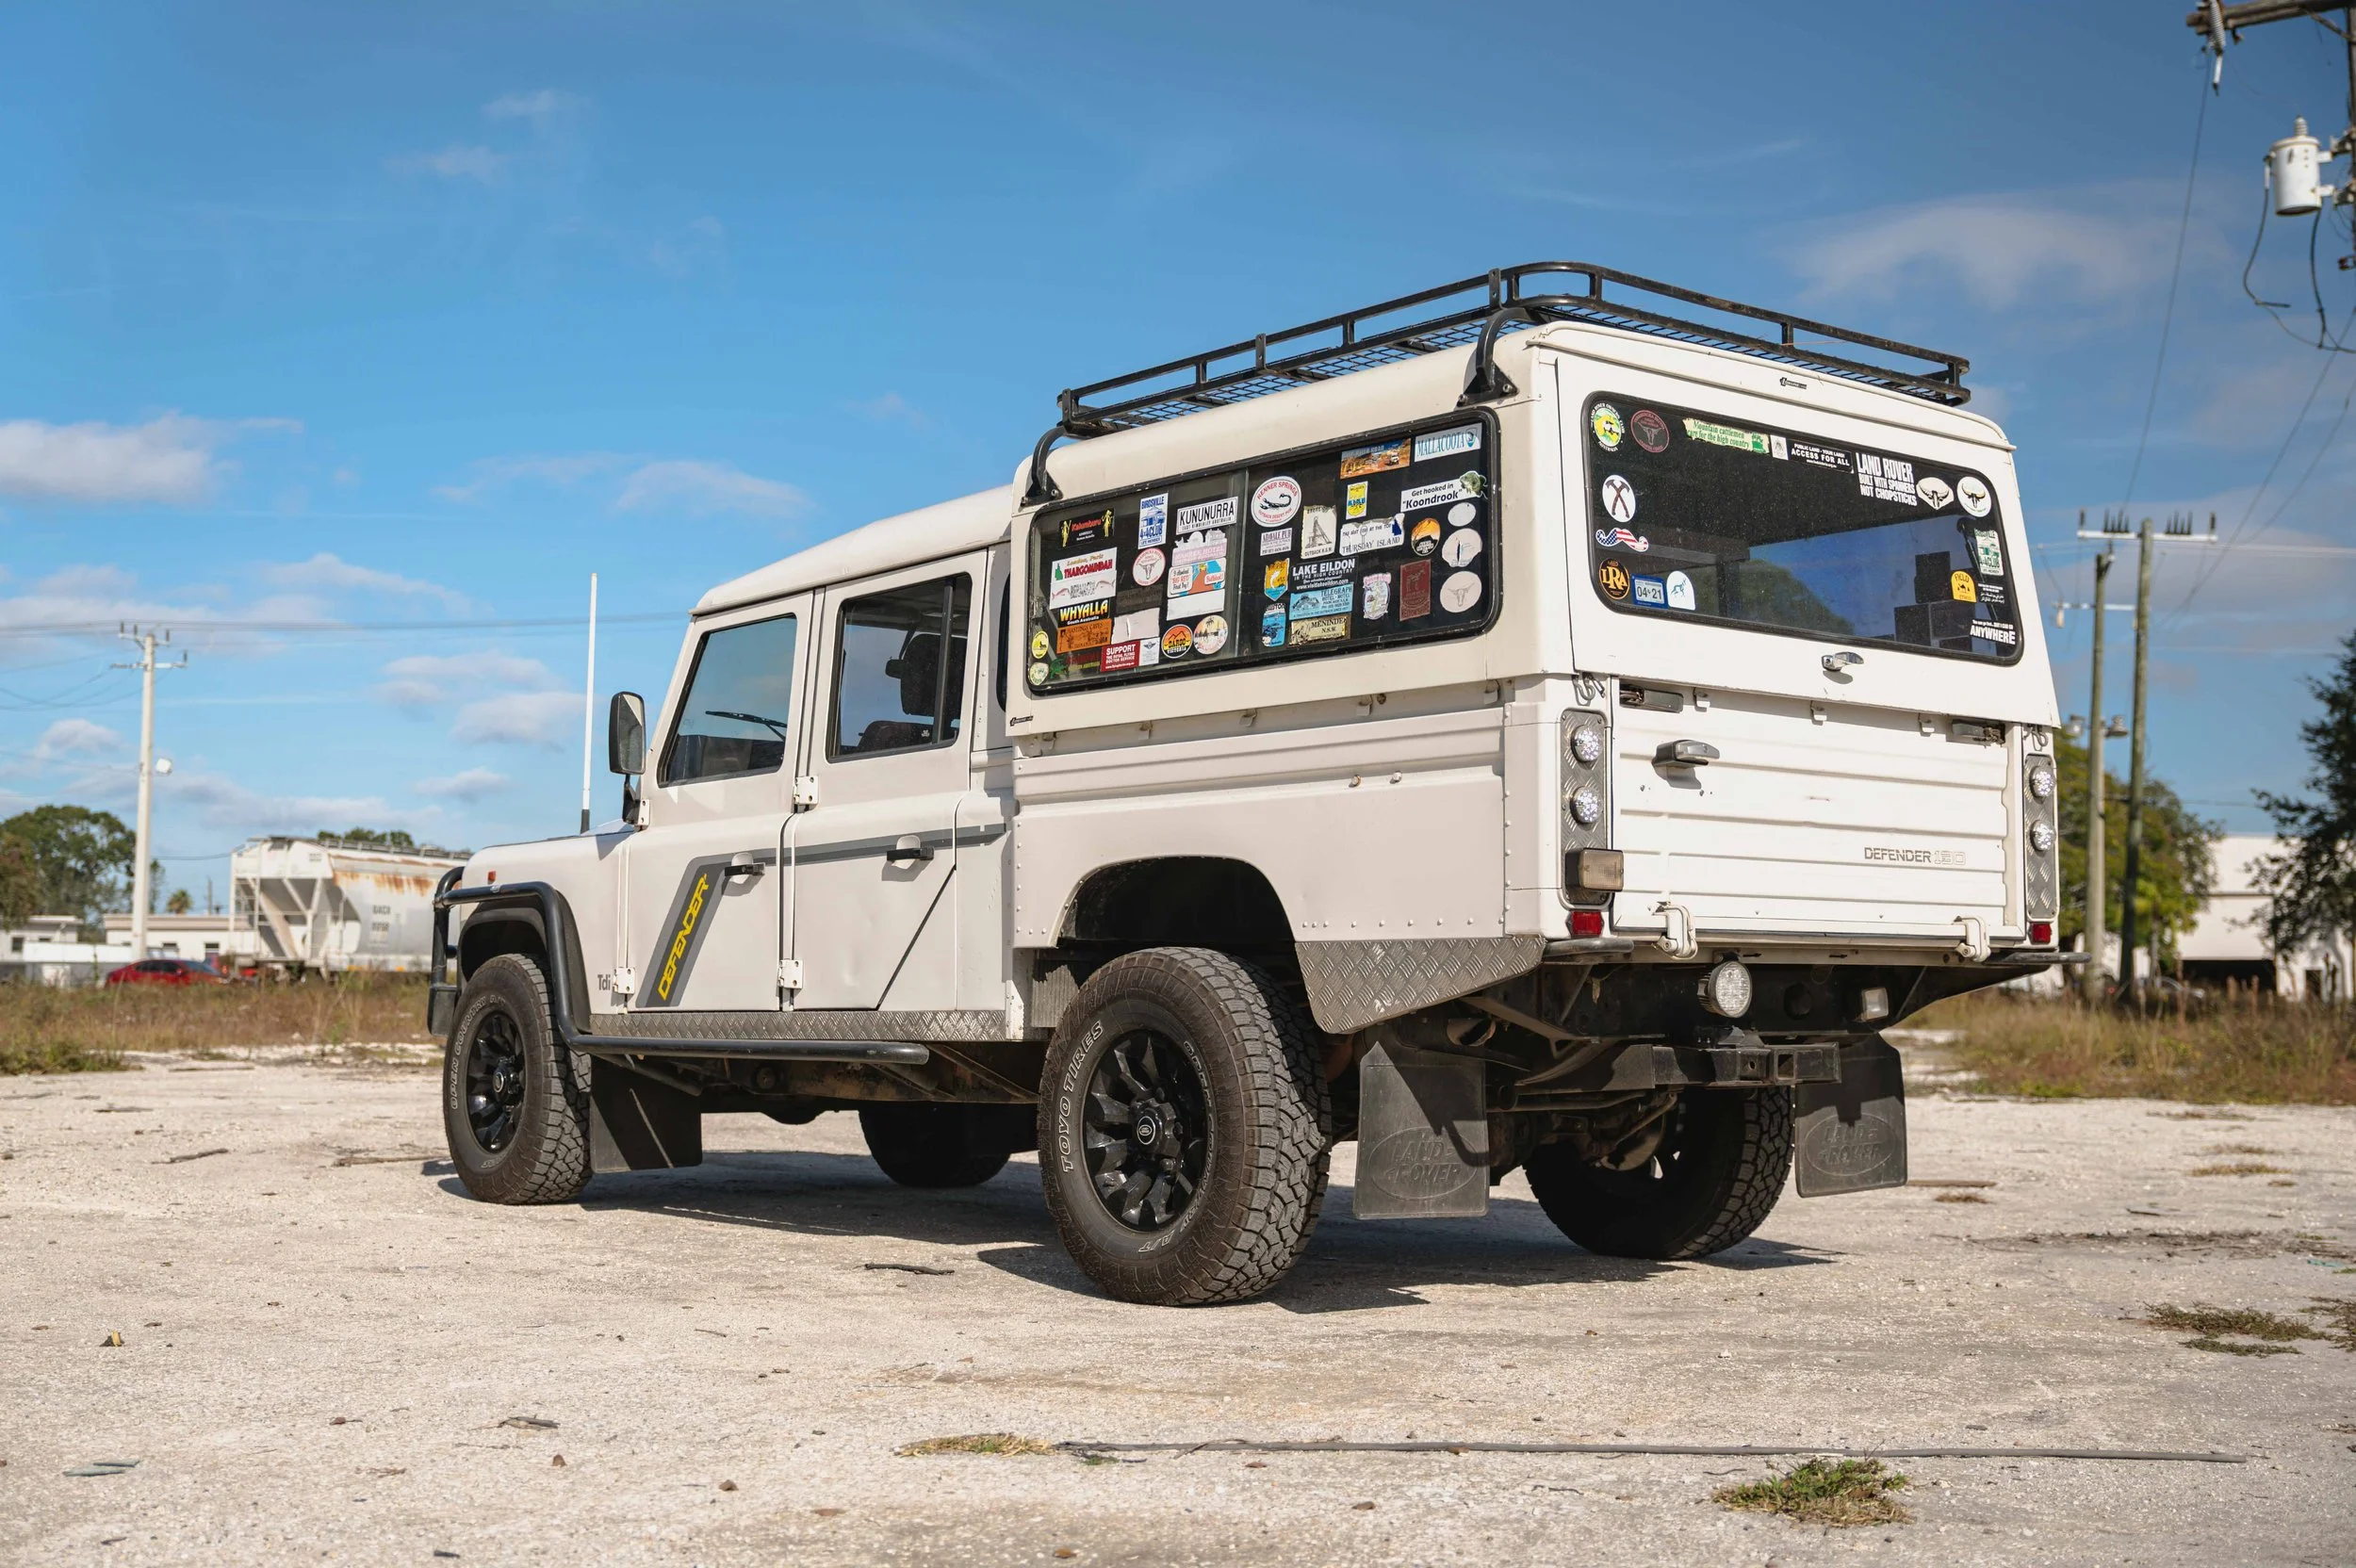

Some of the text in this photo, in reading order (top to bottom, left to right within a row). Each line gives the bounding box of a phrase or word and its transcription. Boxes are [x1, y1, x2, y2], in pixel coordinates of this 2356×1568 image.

[1693, 419, 1744, 439] Mountain cattlemen
[1416, 432, 1465, 457] MALLACOOTA
[1698, 430, 1708, 438] for
[1707, 433, 1716, 441] the
[1716, 434, 1729, 444] high
[1729, 438, 1750, 449] country
[1791, 448, 1850, 466] ACCESS FOR ALL
[1856, 451, 1914, 484] LAND ROVER
[1257, 481, 1298, 499] RENNER SPRINGS
[1423, 484, 1447, 495] hooked
[1857, 472, 1915, 495] BUILT WITH SPANNERS
[1859, 483, 1918, 507] NOT CHOPSTICKS
[1179, 501, 1235, 527] KUNUNURRA
[1342, 536, 1400, 554] THURSDAY ISLAND
[1292, 558, 1356, 577] LAKE EILDON
[1600, 565, 1628, 591] LRA
[1955, 573, 1970, 583] FIELD
[1060, 599, 1108, 622] WHYALLA
[1970, 625, 2016, 645] ANYWHERE
[1106, 644, 1137, 656] SUPPORT
[1864, 846, 1967, 866] DEFENDER 130
[658, 874, 710, 1002] DEFENDER
[597, 973, 612, 991] Tdi
[454, 994, 487, 1056] COUNTRY
[450, 1056, 460, 1110] OPEN
[1058, 1019, 1104, 1173] TOYO TIRES
